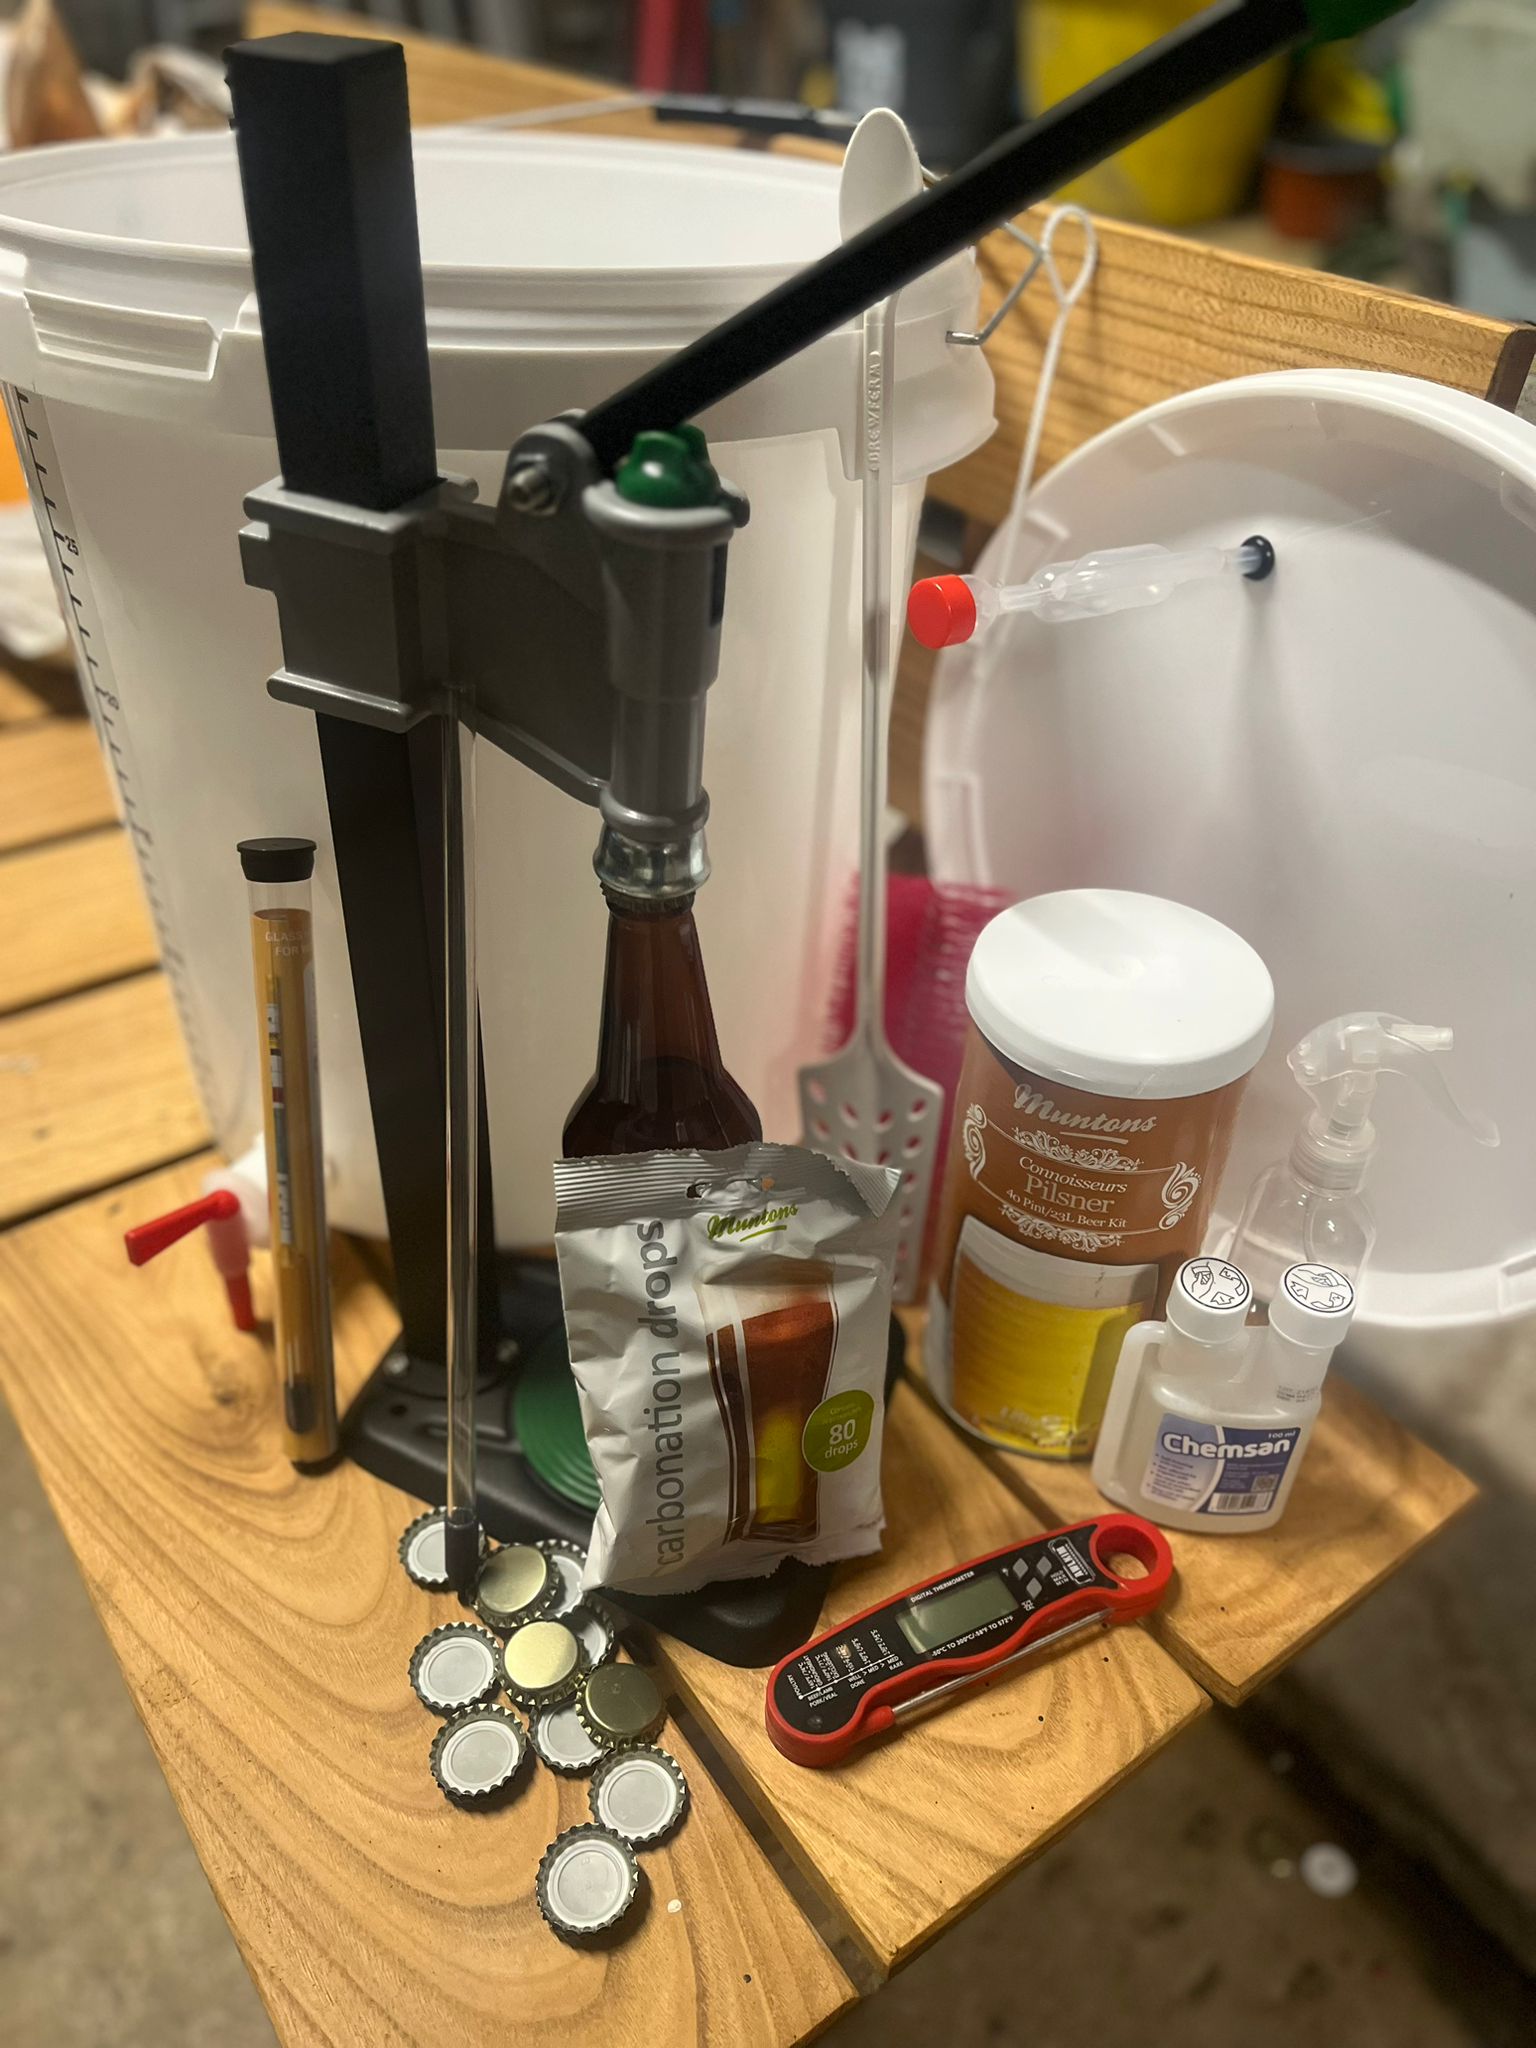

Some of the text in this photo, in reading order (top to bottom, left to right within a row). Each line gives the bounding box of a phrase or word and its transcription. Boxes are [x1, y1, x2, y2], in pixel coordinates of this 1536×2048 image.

[64, 536, 79, 556] 25
[1013, 1083, 1157, 1133] Muntons
[1019, 1156, 1128, 1193] Connoisseurs
[1006, 1189, 1127, 1228] 40 Pint/23L Beer Kit
[1024, 1174, 1116, 1214] Pilsner
[707, 1202, 800, 1240] Muntons
[635, 1219, 686, 1568] carbonation drops
[829, 1418, 856, 1445] 80
[1162, 1433, 1291, 1459] Chemsan
[1267, 1431, 1283, 1439] 100
[824, 1439, 859, 1459] drops
[1056, 1545, 1084, 1578] AWLKIN
[910, 1570, 975, 1603] DIGITAL THERMOMETER
[988, 1622, 998, 1631] TO
